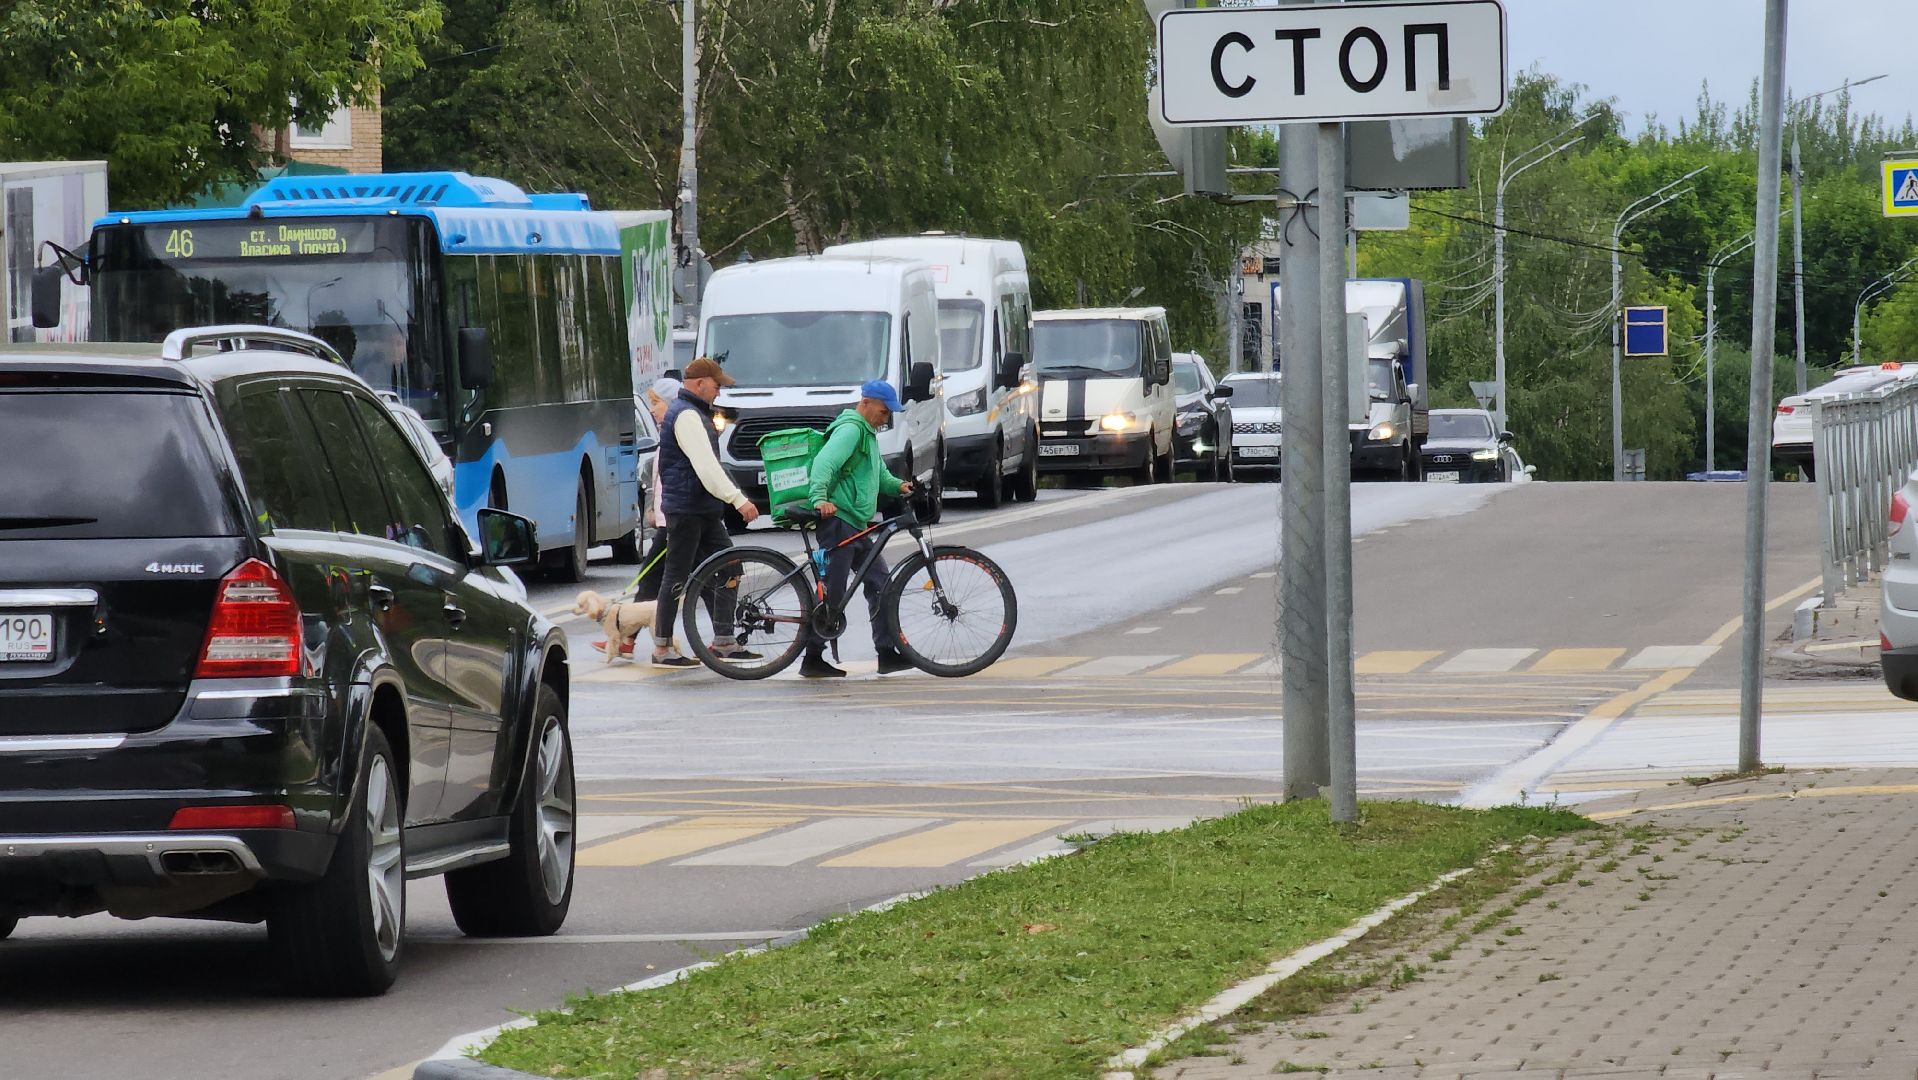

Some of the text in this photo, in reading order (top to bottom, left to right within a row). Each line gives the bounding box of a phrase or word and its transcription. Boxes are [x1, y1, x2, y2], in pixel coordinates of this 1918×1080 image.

[1210, 22, 1450, 98] СТОП
[165, 229, 194, 258] 46
[250, 225, 337, 243] ст. Одинцово
[240, 238, 347, 257] Власиха (почта)
[145, 562, 205, 574] 4MATIC
[0, 618, 42, 641] 190
[8, 642, 31, 651] RUS
